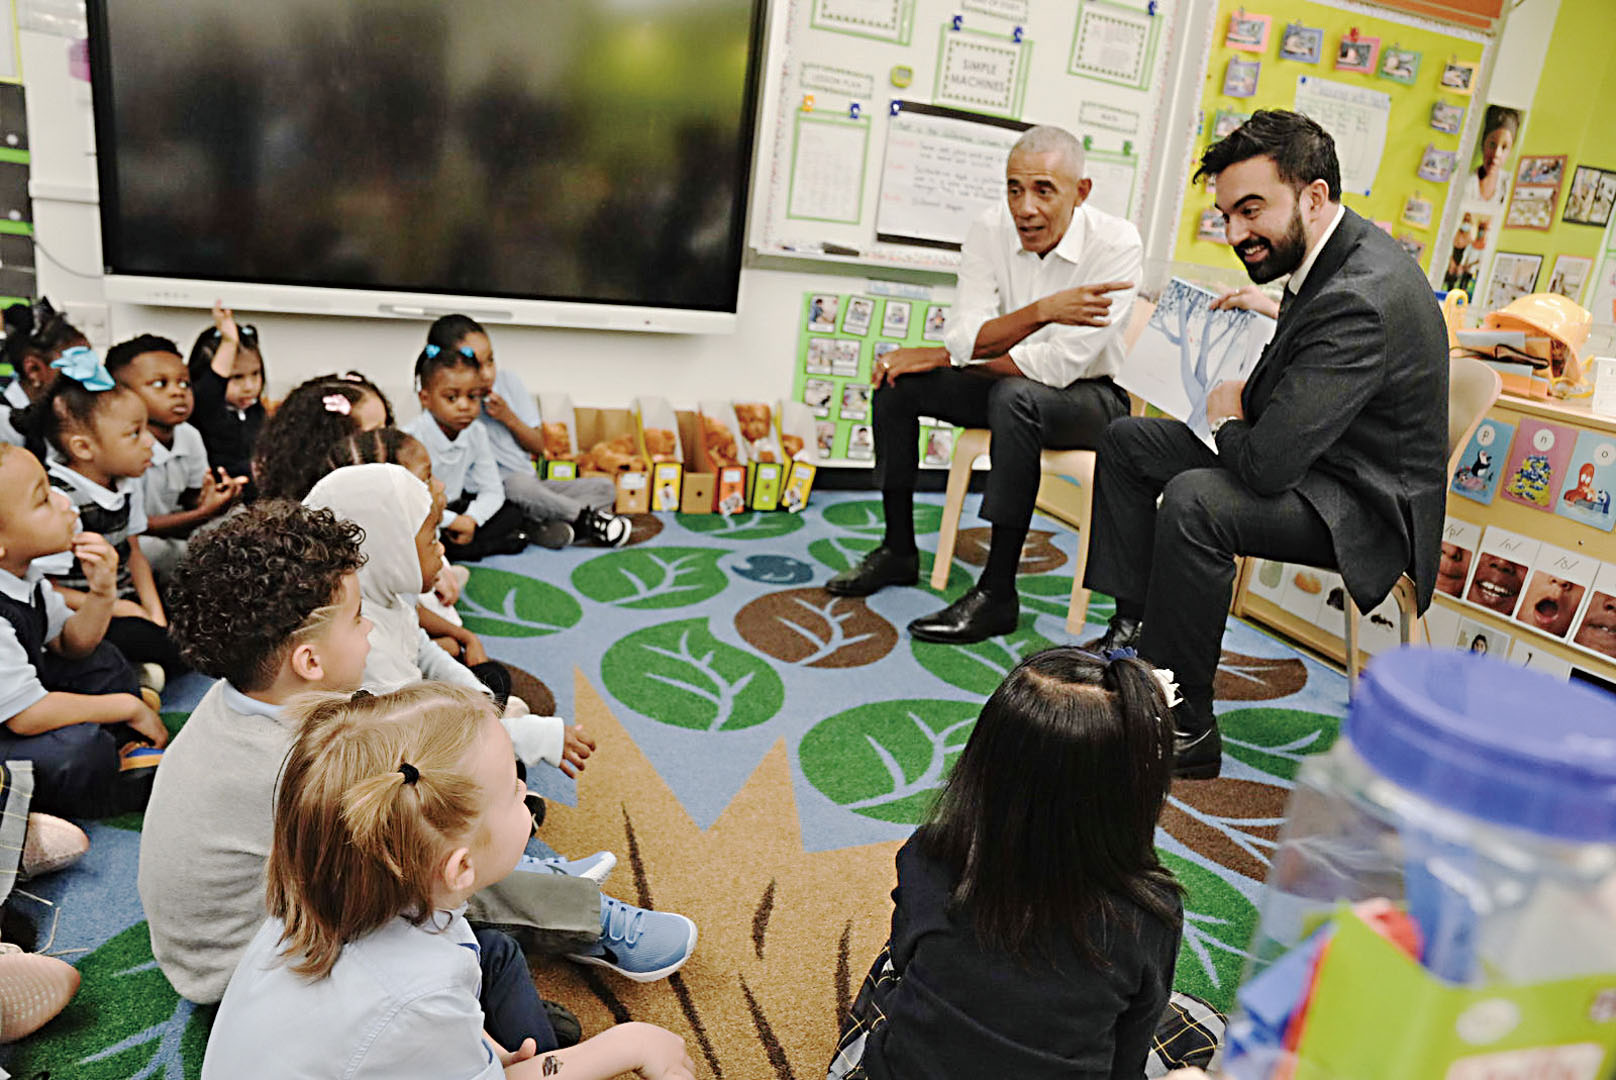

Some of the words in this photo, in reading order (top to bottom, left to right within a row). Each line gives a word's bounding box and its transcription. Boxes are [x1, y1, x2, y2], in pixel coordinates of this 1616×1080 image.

[962, 58, 997, 75] SIMPLE
[951, 73, 1005, 92] MACHINES
[1540, 436, 1548, 444] n
[1601, 450, 1609, 458] o
